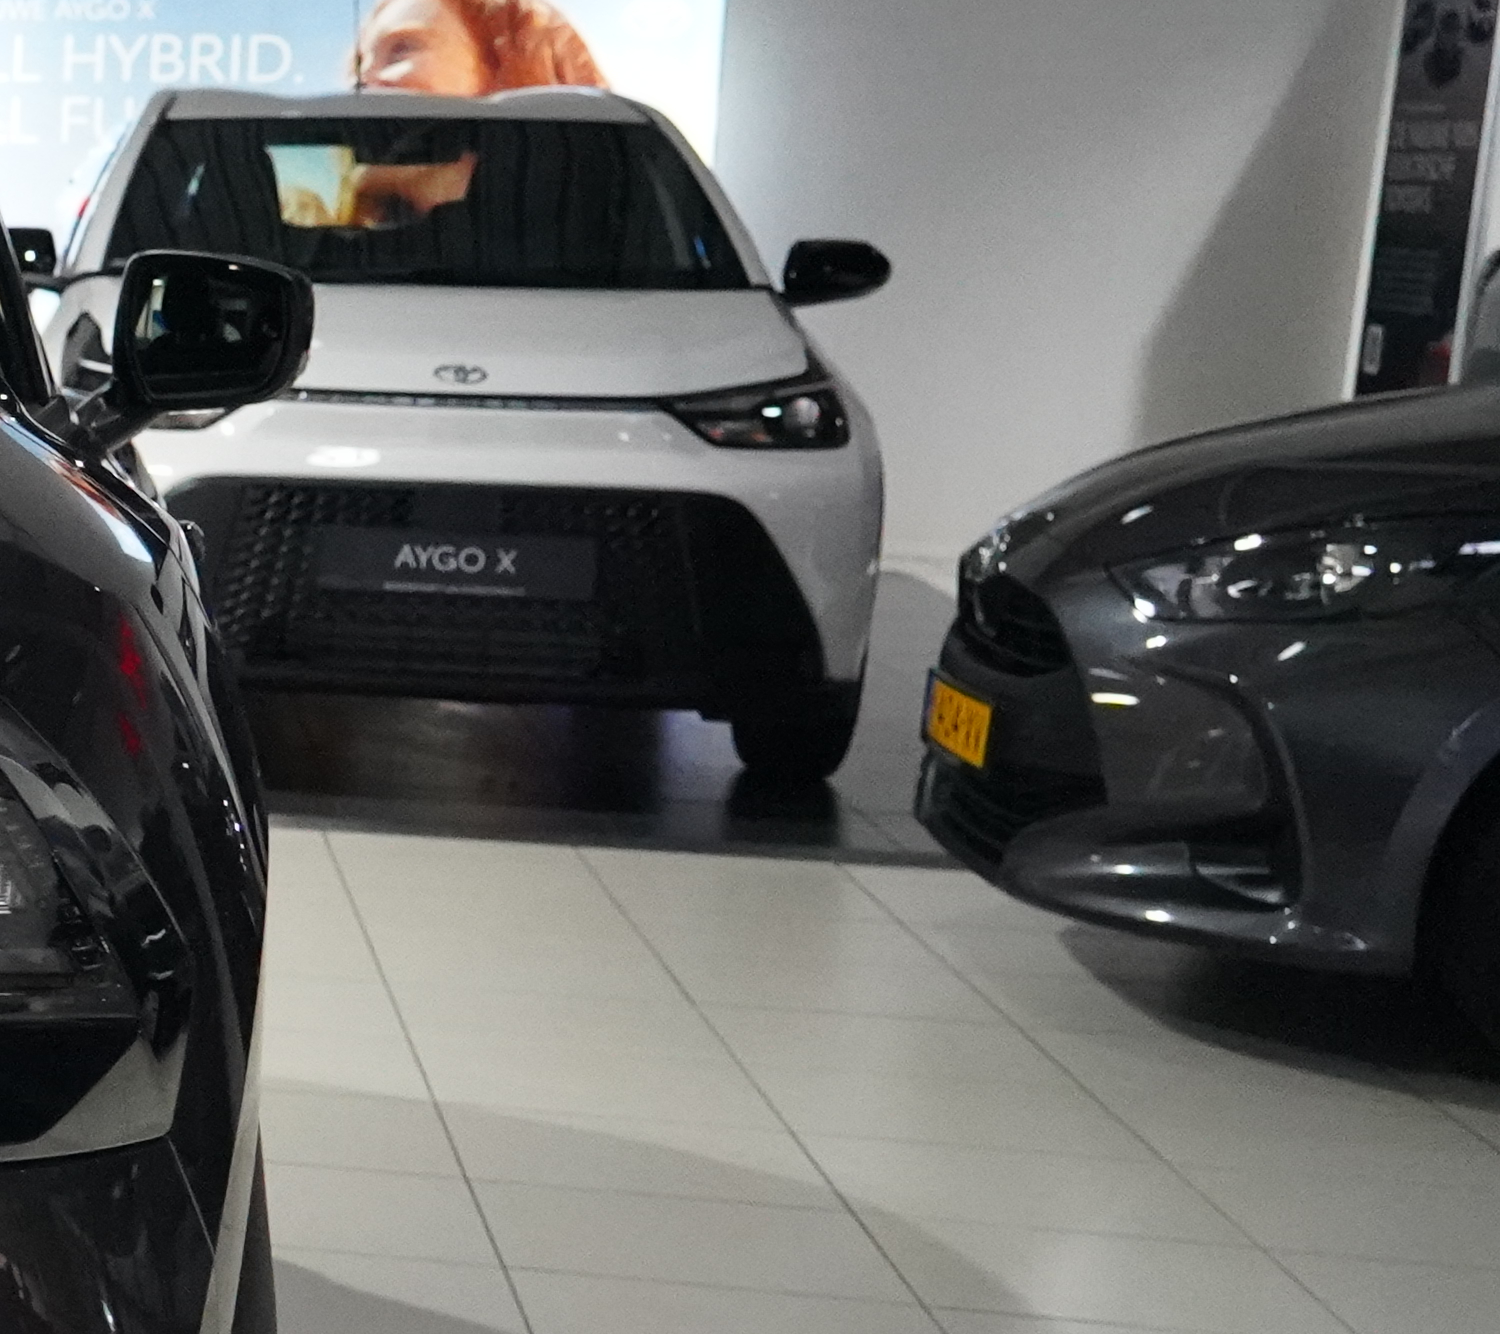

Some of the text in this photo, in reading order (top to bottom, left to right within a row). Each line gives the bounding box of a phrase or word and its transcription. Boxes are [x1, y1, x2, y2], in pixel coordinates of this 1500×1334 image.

[63, 33, 306, 85] HYBRID.
[394, 544, 518, 574] AYGO X
